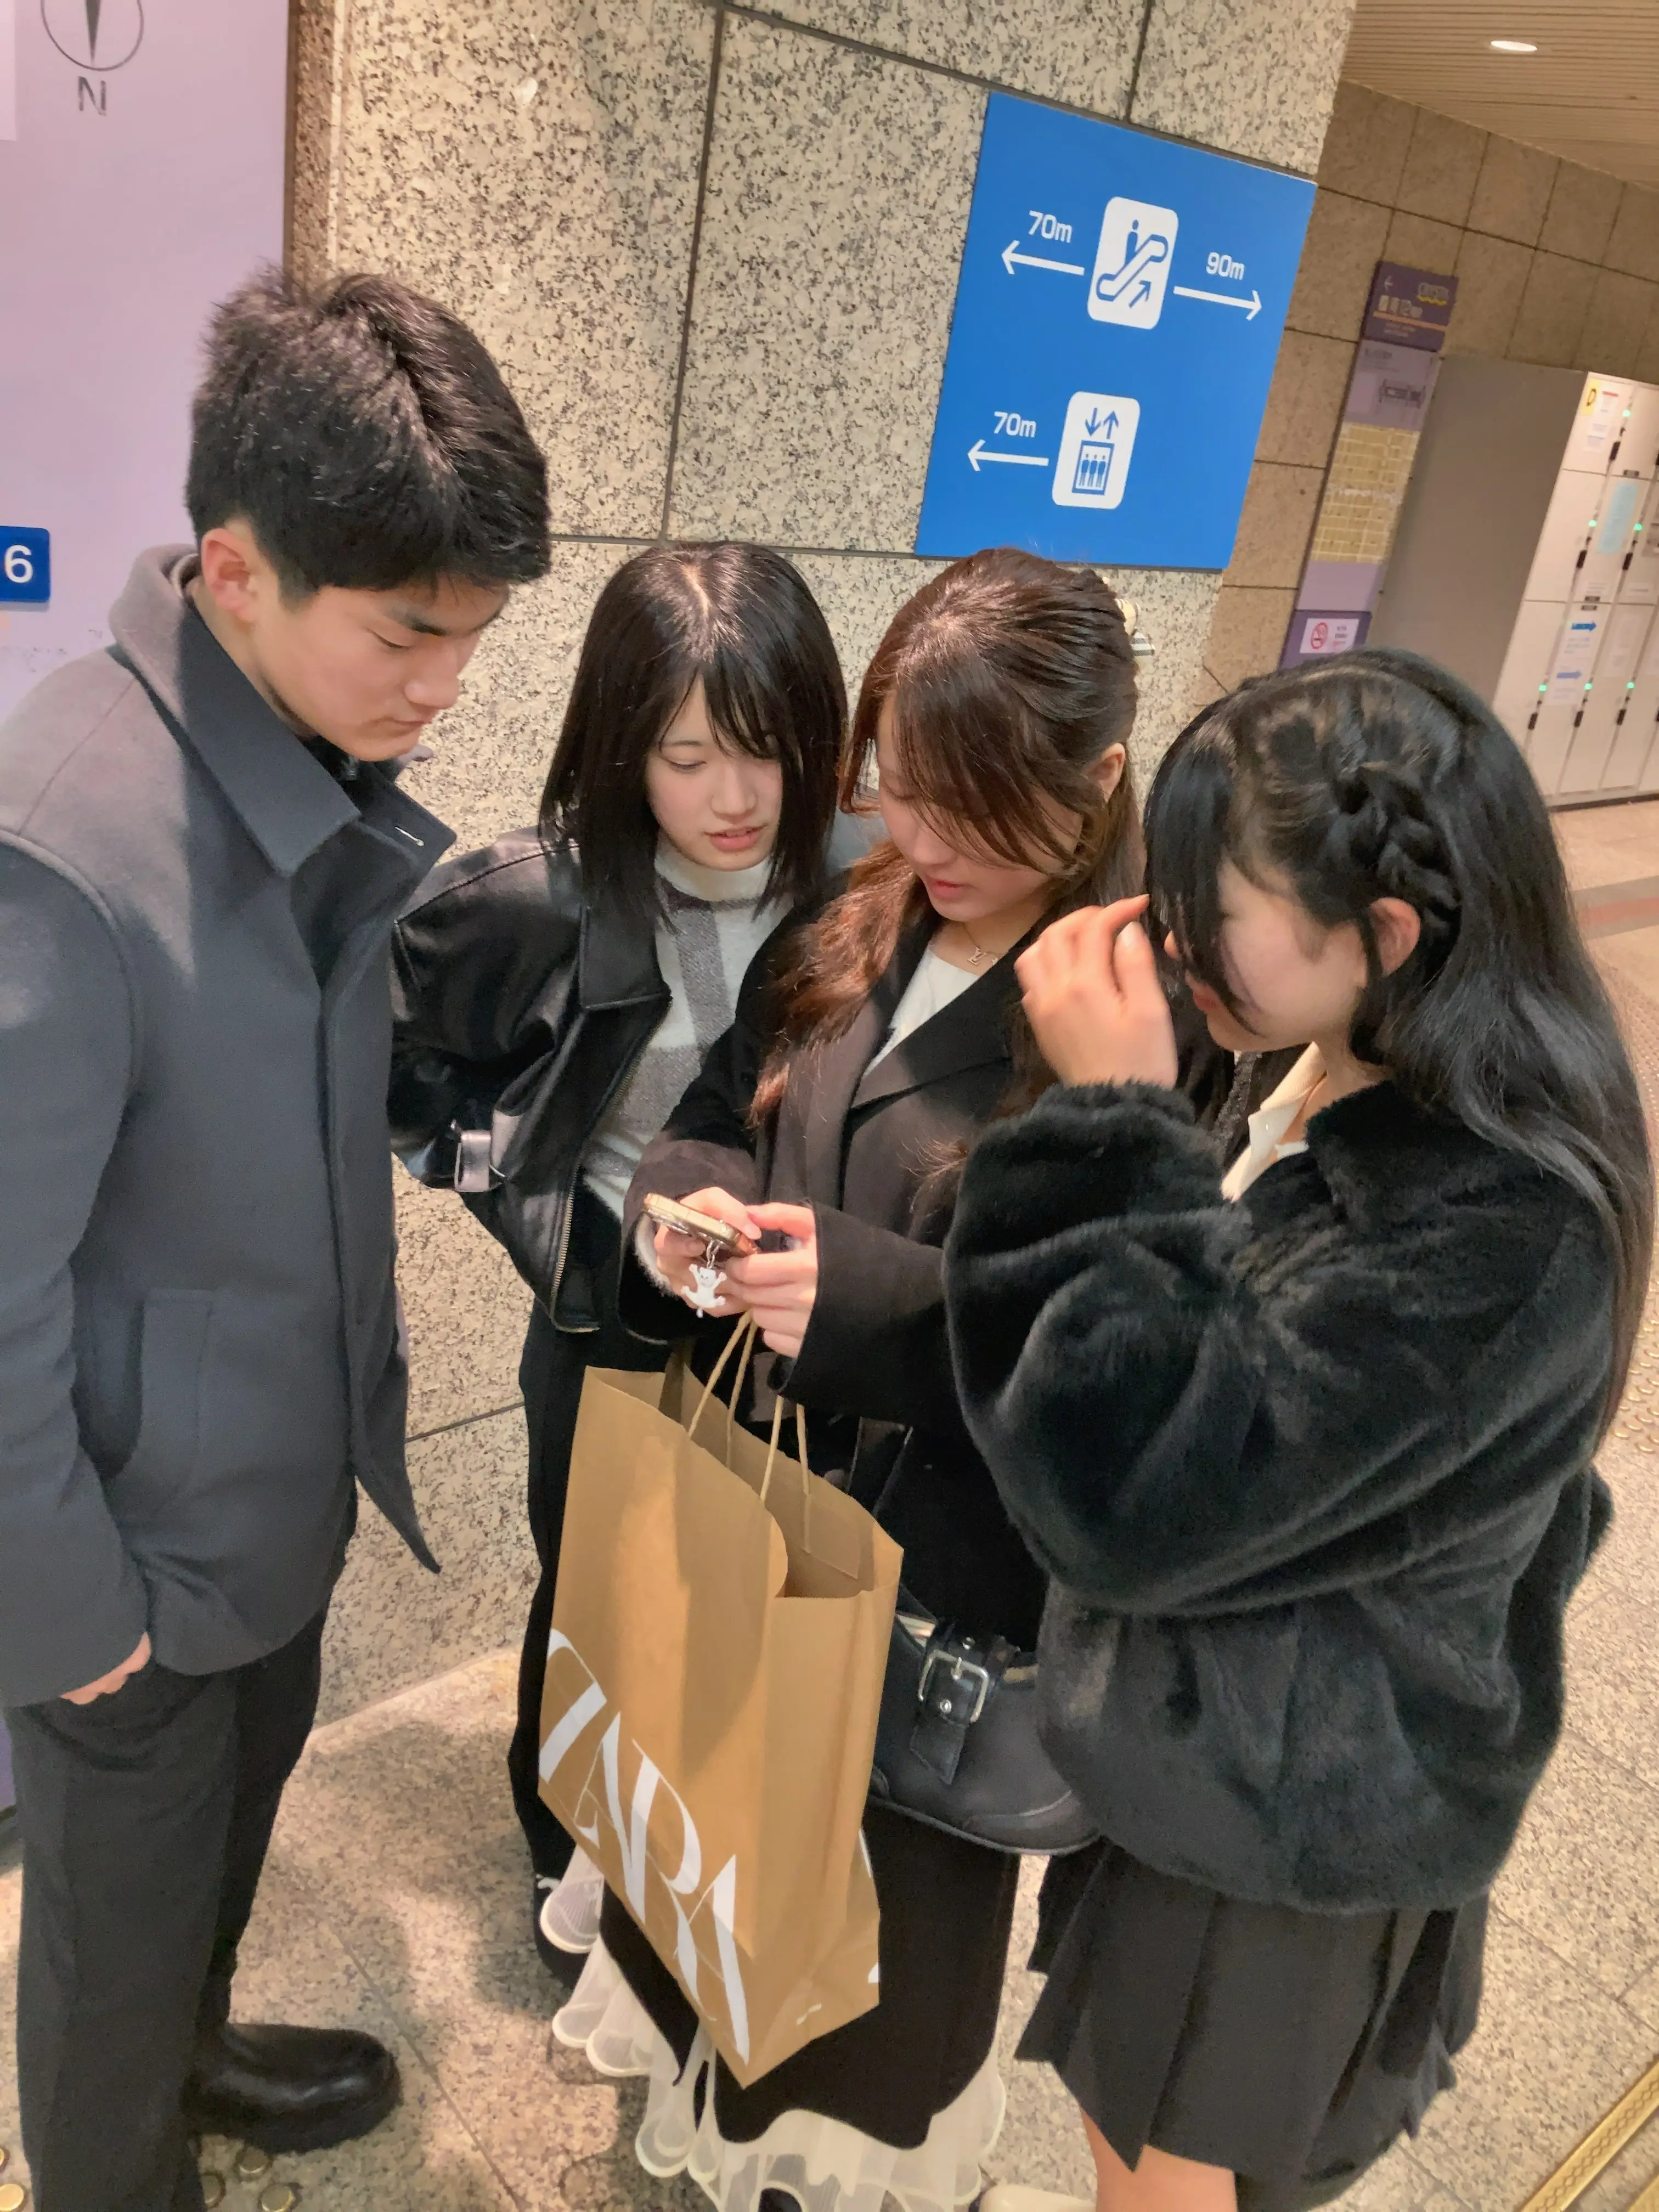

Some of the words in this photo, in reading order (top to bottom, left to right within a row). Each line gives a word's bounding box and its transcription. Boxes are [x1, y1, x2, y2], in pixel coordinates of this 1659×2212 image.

[78, 76, 106, 116] N
[1028, 210, 1072, 244] 70m
[1206, 252, 1245, 280] 90m
[993, 411, 1036, 438] 70m
